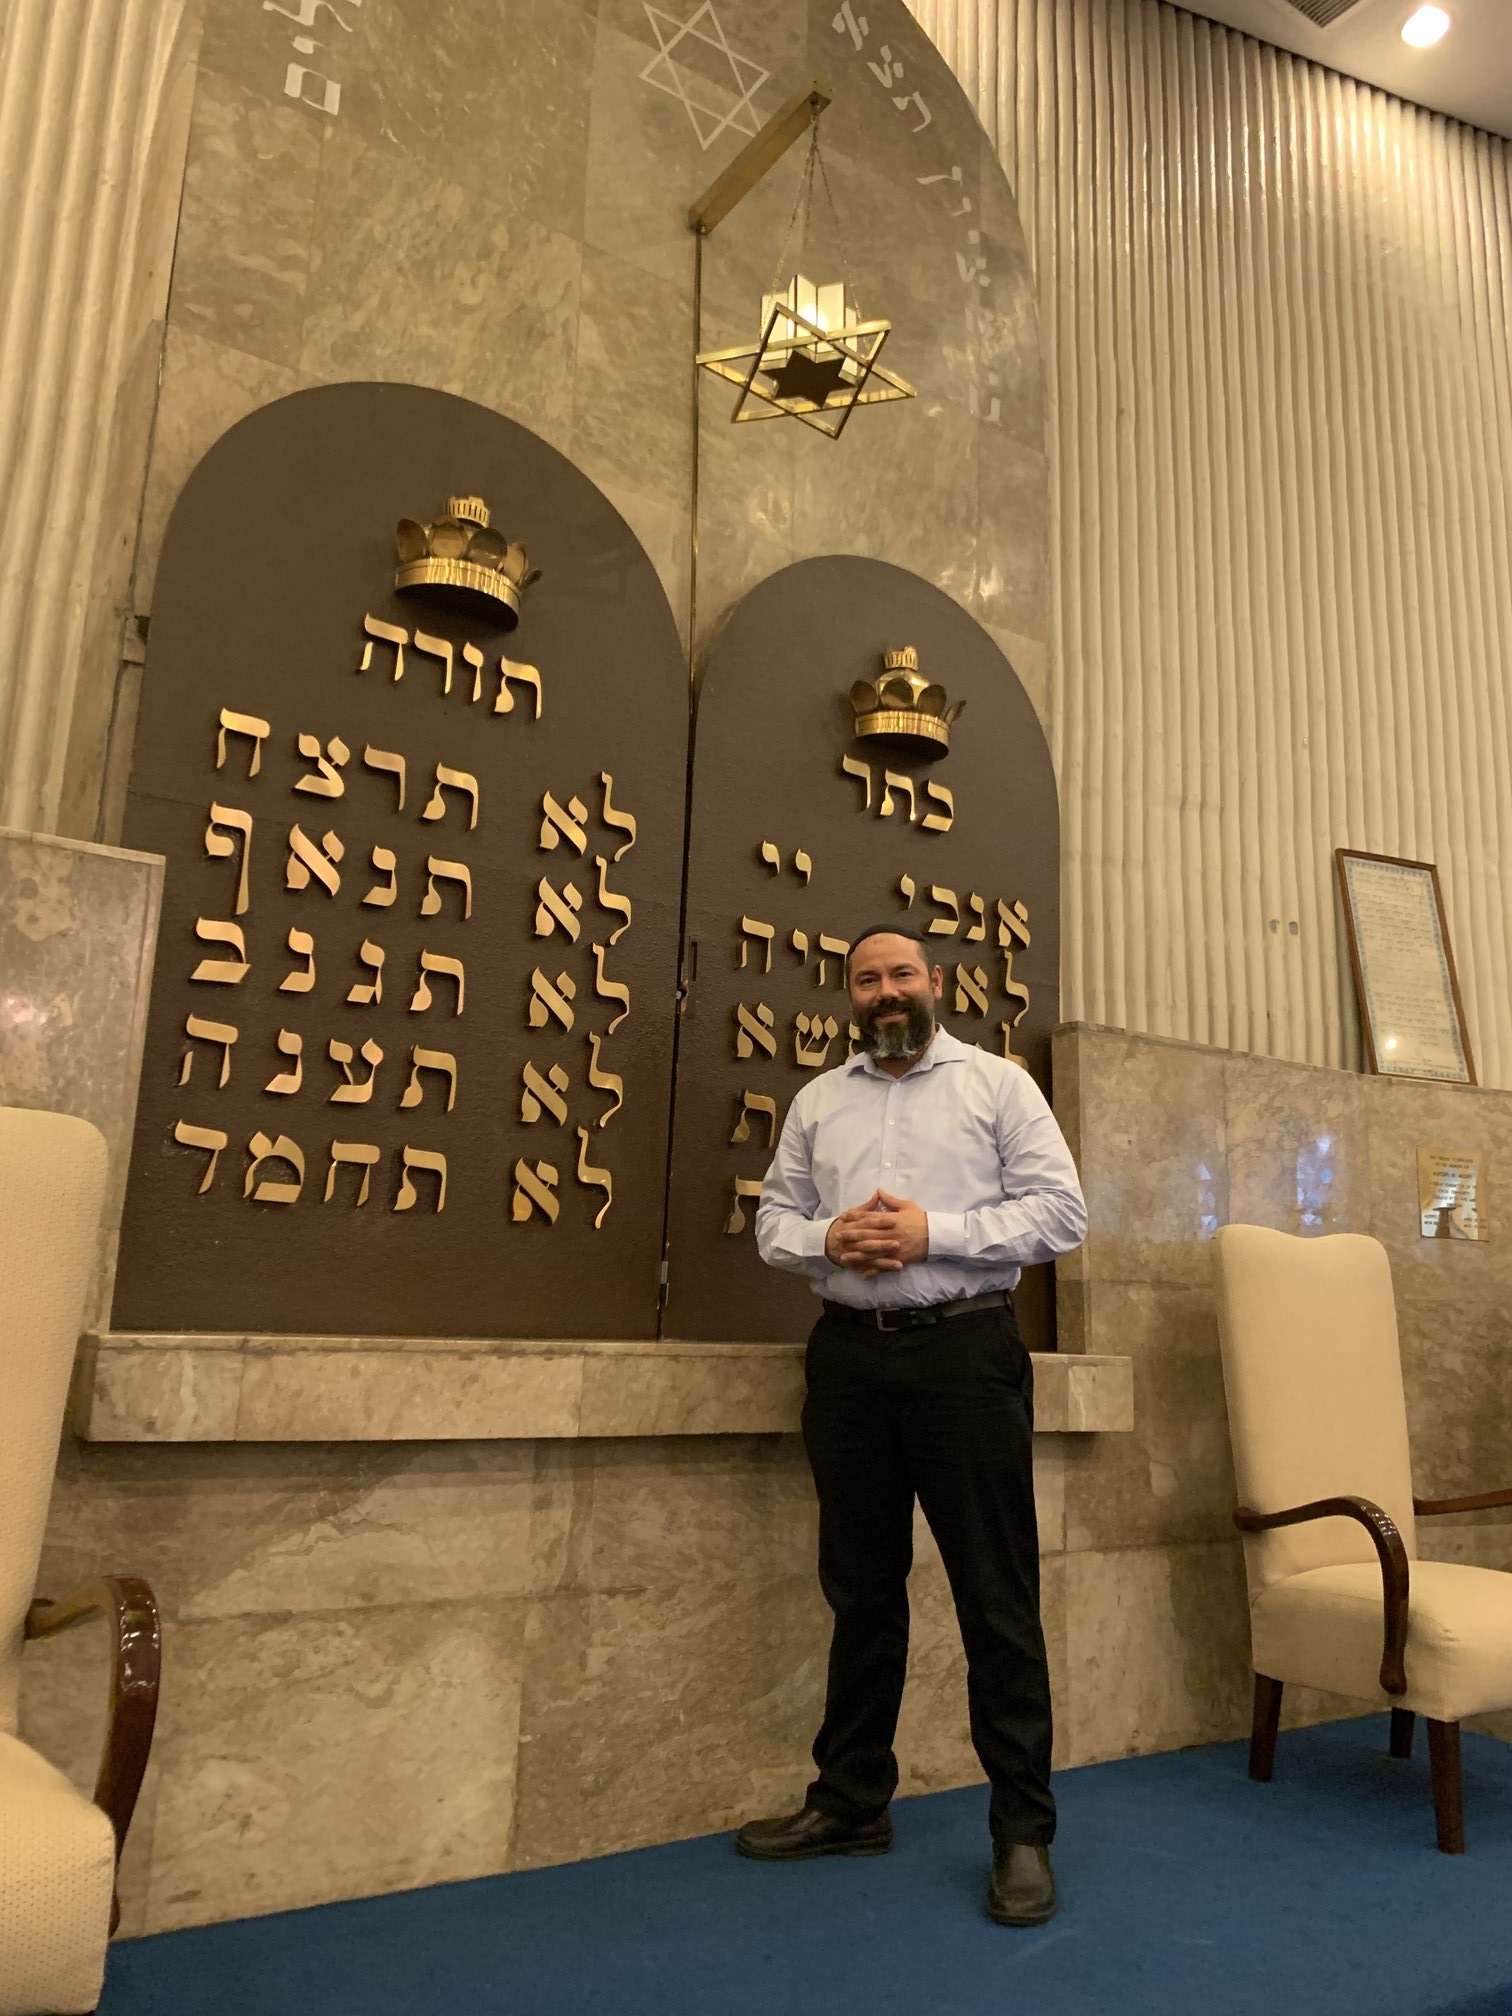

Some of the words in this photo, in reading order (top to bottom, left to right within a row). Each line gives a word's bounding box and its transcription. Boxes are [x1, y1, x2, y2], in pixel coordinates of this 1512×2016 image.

[359, 612, 543, 720] תורה
[216, 706, 480, 830] תרצח
[842, 754, 954, 832] כתר
[204, 800, 473, 920] תנאף
[539, 770, 637, 863] לא
[761, 840, 813, 885] יי
[534, 854, 632, 946] לא
[900, 872, 1031, 950] אנכי
[190, 916, 465, 1016] תגנב
[528, 941, 630, 1035] לא
[739, 914, 851, 989] היה
[955, 949, 1030, 1028] לא
[178, 1013, 457, 1112] תענה
[521, 1031, 624, 1128] לא
[174, 1118, 448, 1213] תחמד
[512, 1125, 613, 1230] לא
